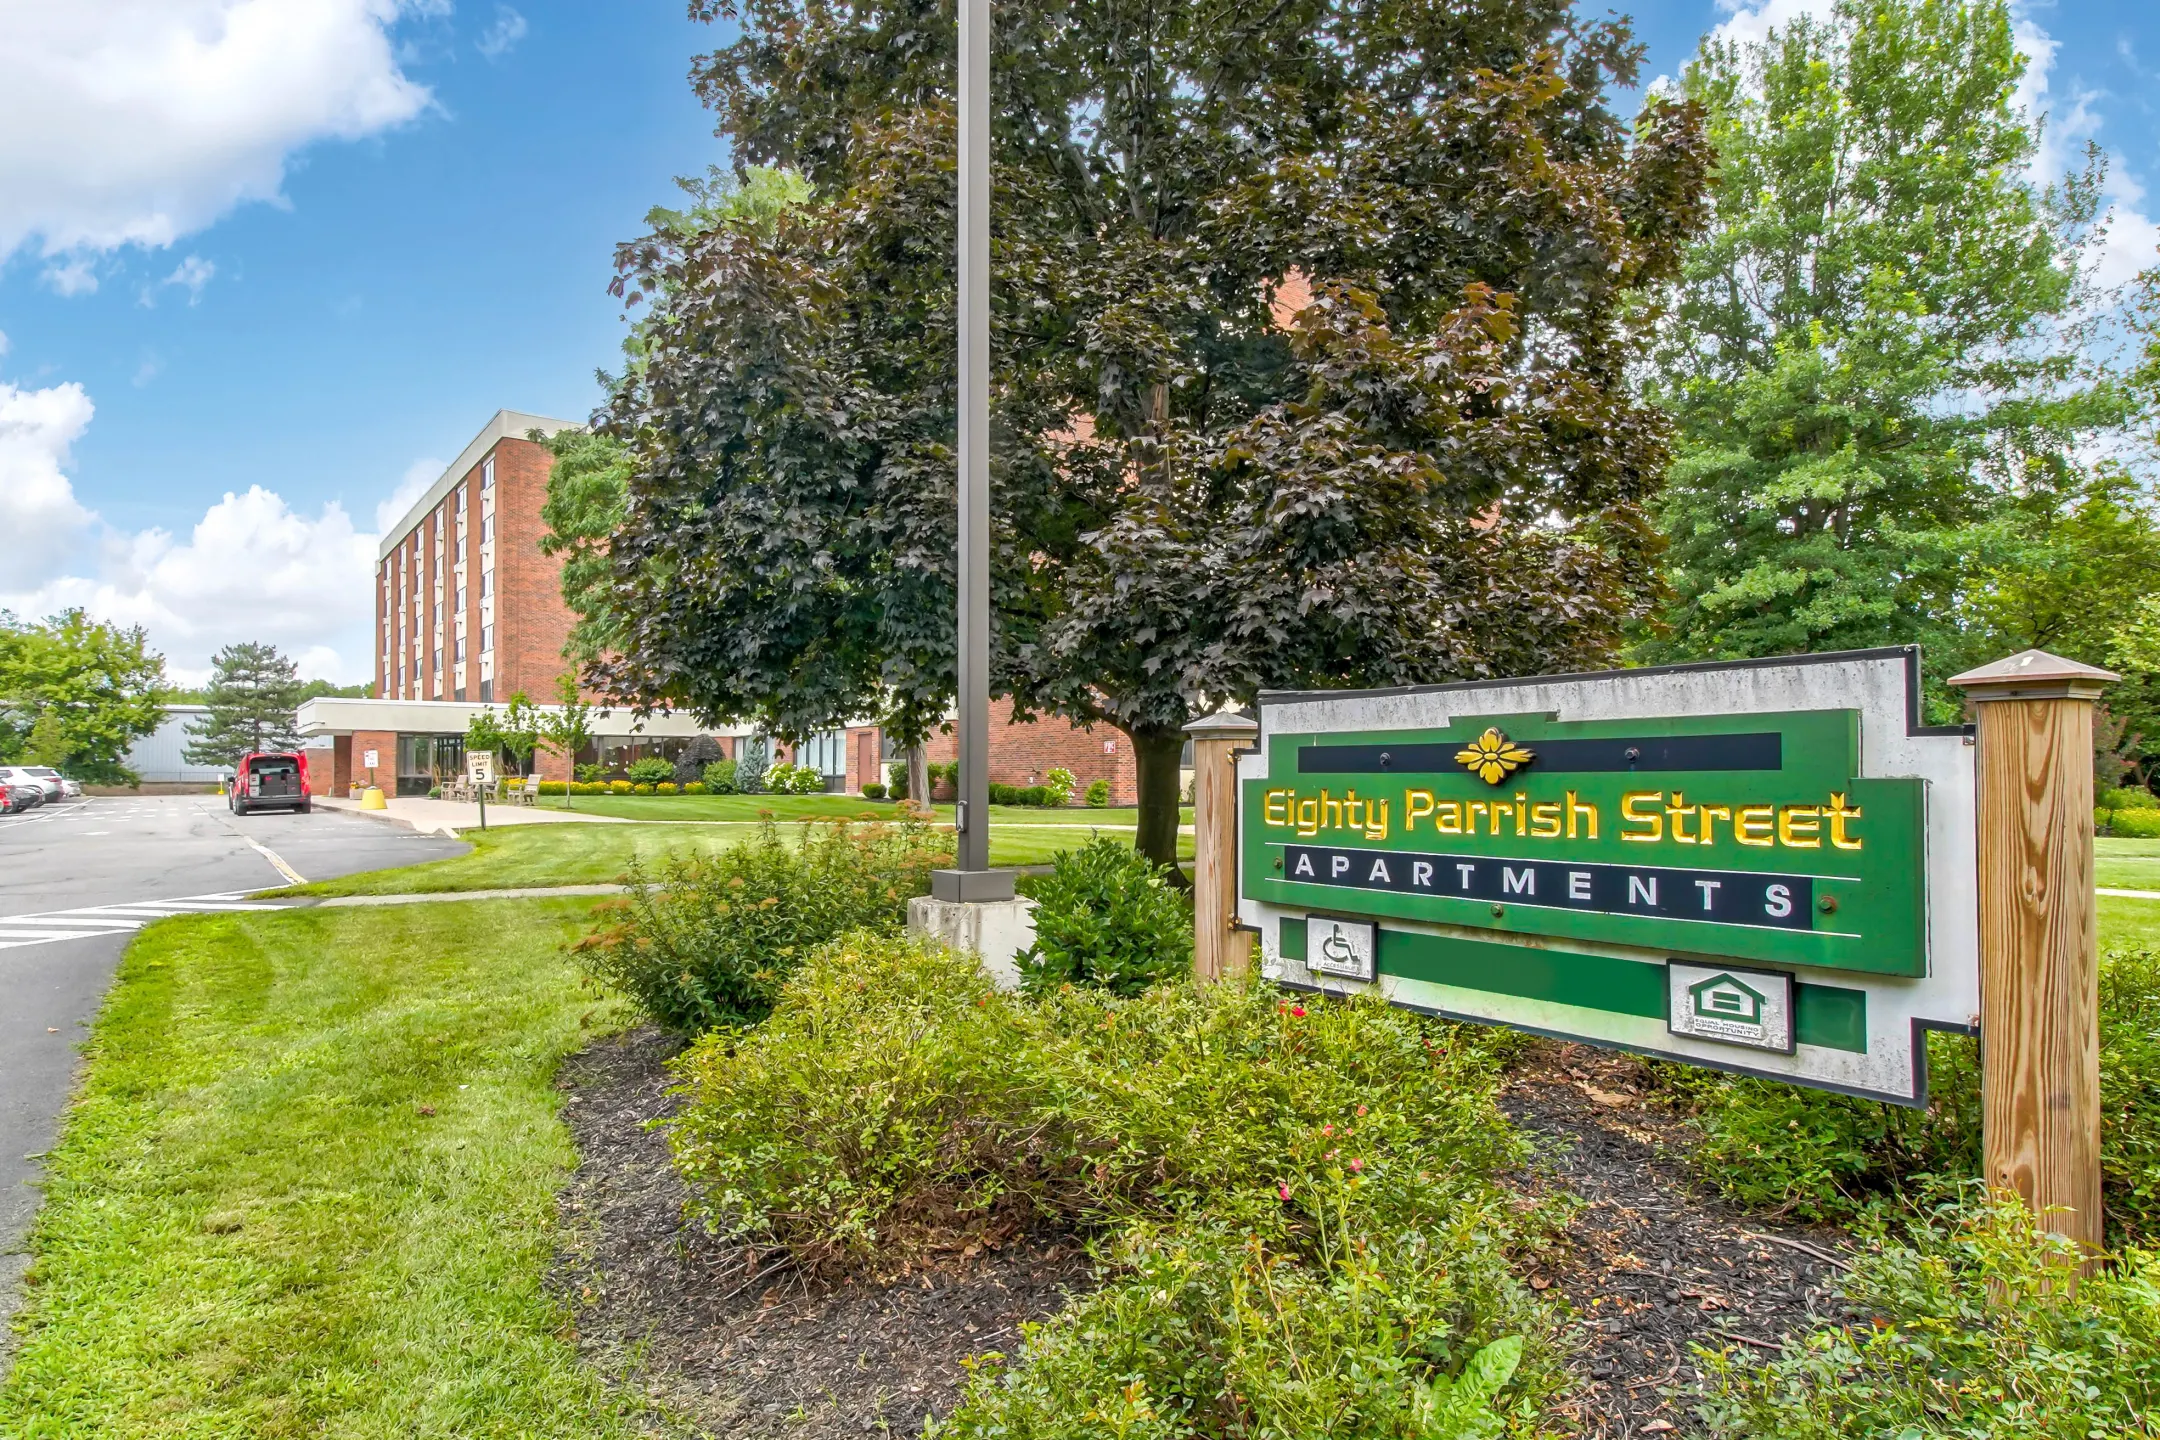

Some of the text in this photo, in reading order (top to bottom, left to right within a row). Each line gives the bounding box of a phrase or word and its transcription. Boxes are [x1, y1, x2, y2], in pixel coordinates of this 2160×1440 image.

[475, 768, 485, 780] 5
[1264, 788, 1862, 850] Eighty Parrish Street
[1295, 853, 1792, 918] APARTMENTS
[1695, 1018, 1759, 1032] EQUAL HOUSING
[1695, 1022, 1759, 1037] OPPORTUNITY
